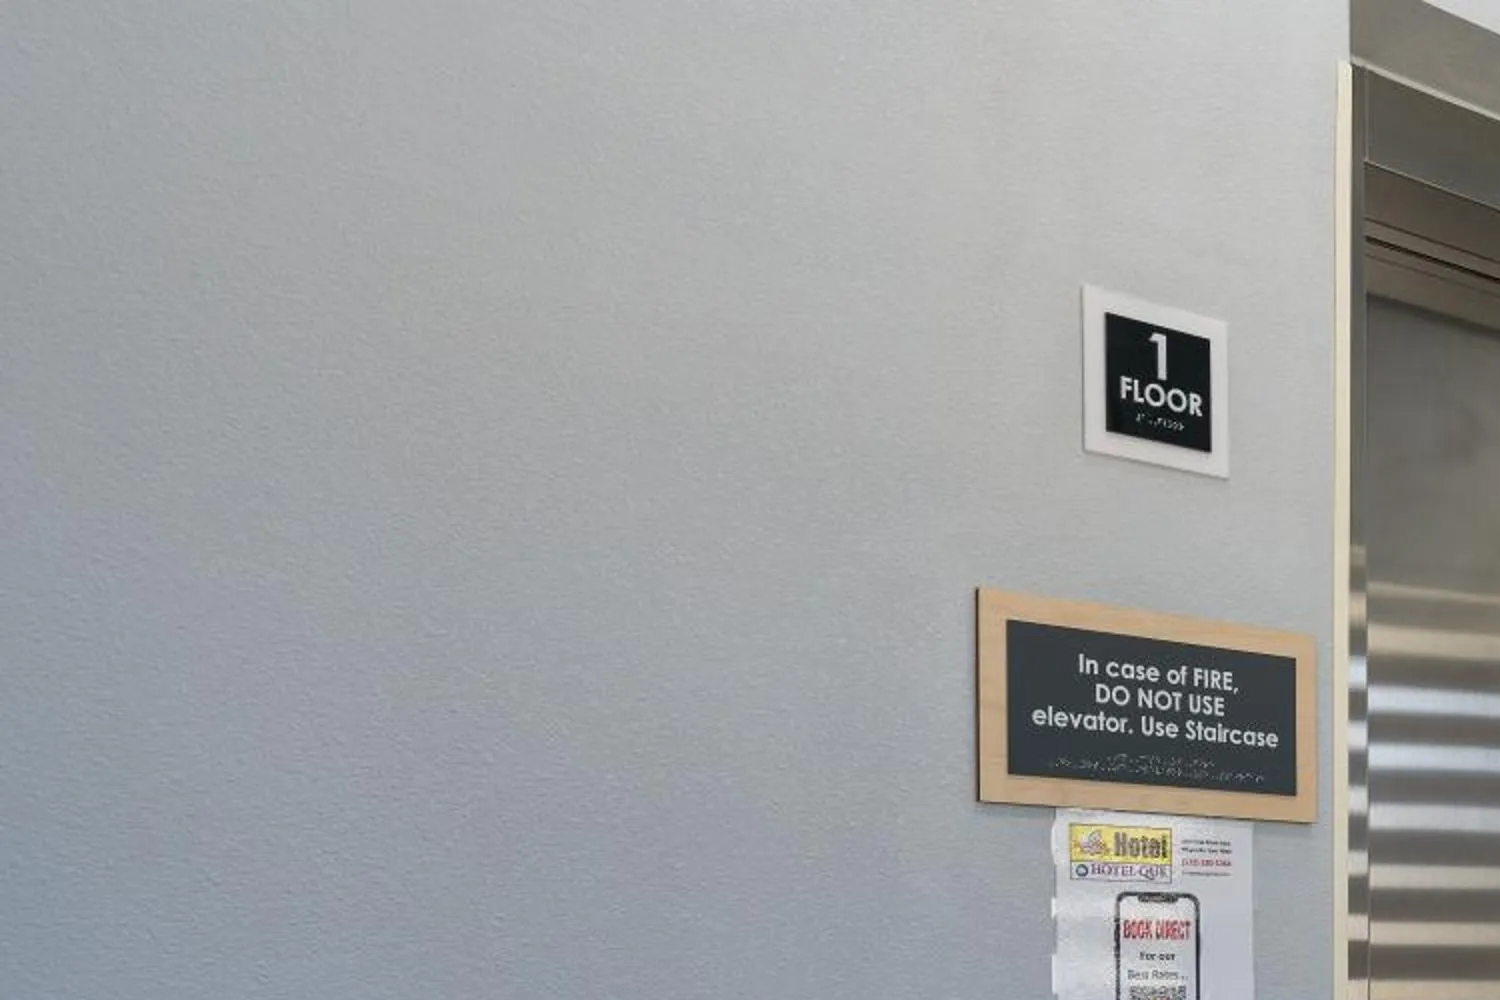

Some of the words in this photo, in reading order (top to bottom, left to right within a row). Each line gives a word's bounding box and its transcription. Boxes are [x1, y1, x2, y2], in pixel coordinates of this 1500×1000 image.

[1149, 332, 1167, 381] 1
[1119, 375, 1203, 417] FLOOR
[1078, 653, 1099, 675] In
[1105, 660, 1159, 683] case
[1166, 664, 1188, 686] of
[1192, 667, 1239, 694] FIRE,
[1095, 683, 1131, 706] DO
[1137, 690, 1184, 713] NOT
[1188, 695, 1225, 717] USE
[1031, 706, 1134, 735] elevator.
[1140, 715, 1179, 739] Use
[1184, 720, 1280, 749] Staircase
[1114, 832, 1169, 859] Hotel
[1123, 919, 1153, 940] BOOK
[1155, 919, 1191, 941] DIRECT
